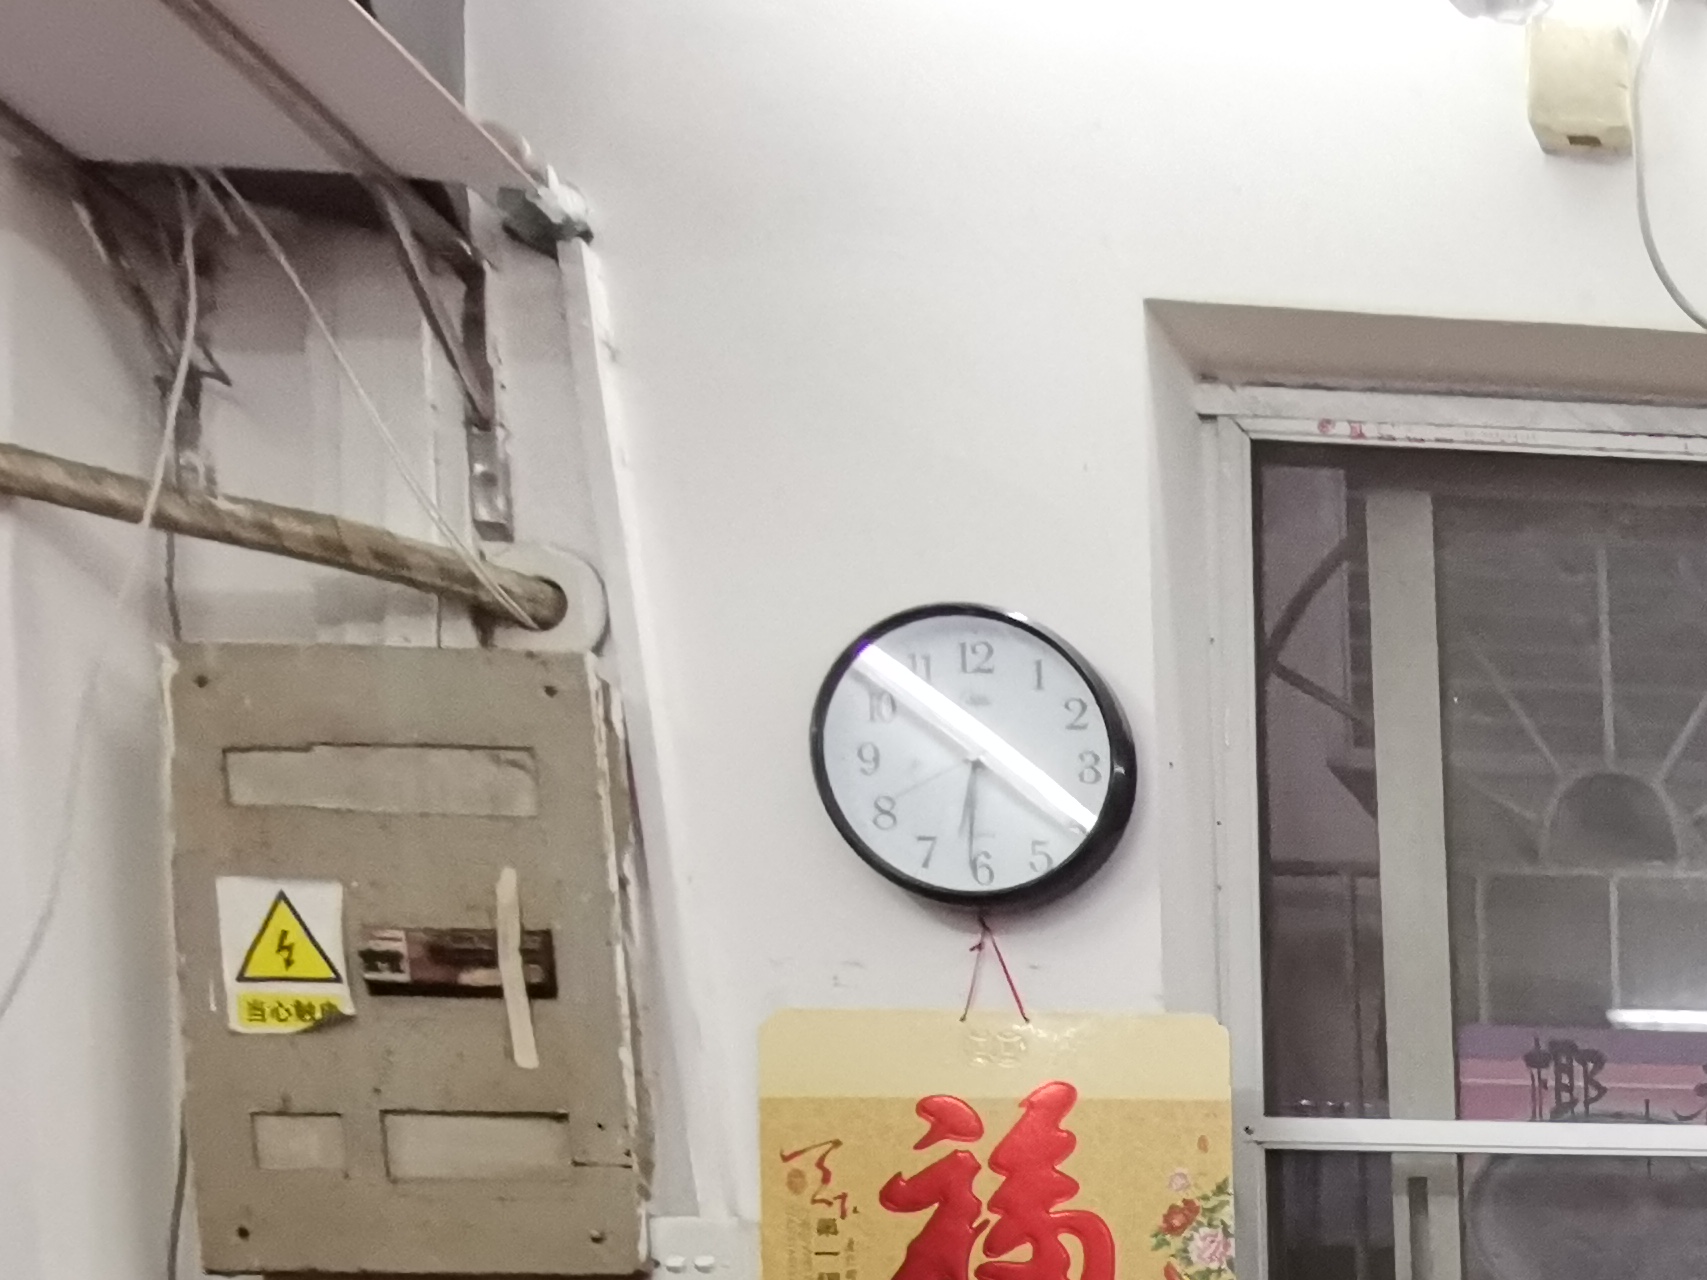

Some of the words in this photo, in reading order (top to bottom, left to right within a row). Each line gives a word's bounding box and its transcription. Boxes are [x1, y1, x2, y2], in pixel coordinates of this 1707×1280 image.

[960, 641, 995, 674] 12
[1033, 659, 1044, 691] 1
[1064, 697, 1088, 730] 2
[857, 742, 880, 777] 9
[1078, 751, 1102, 785] 3
[872, 796, 897, 830] 8
[916, 836, 937, 869] 7
[972, 850, 995, 886] 6
[1029, 840, 1053, 873] 5
